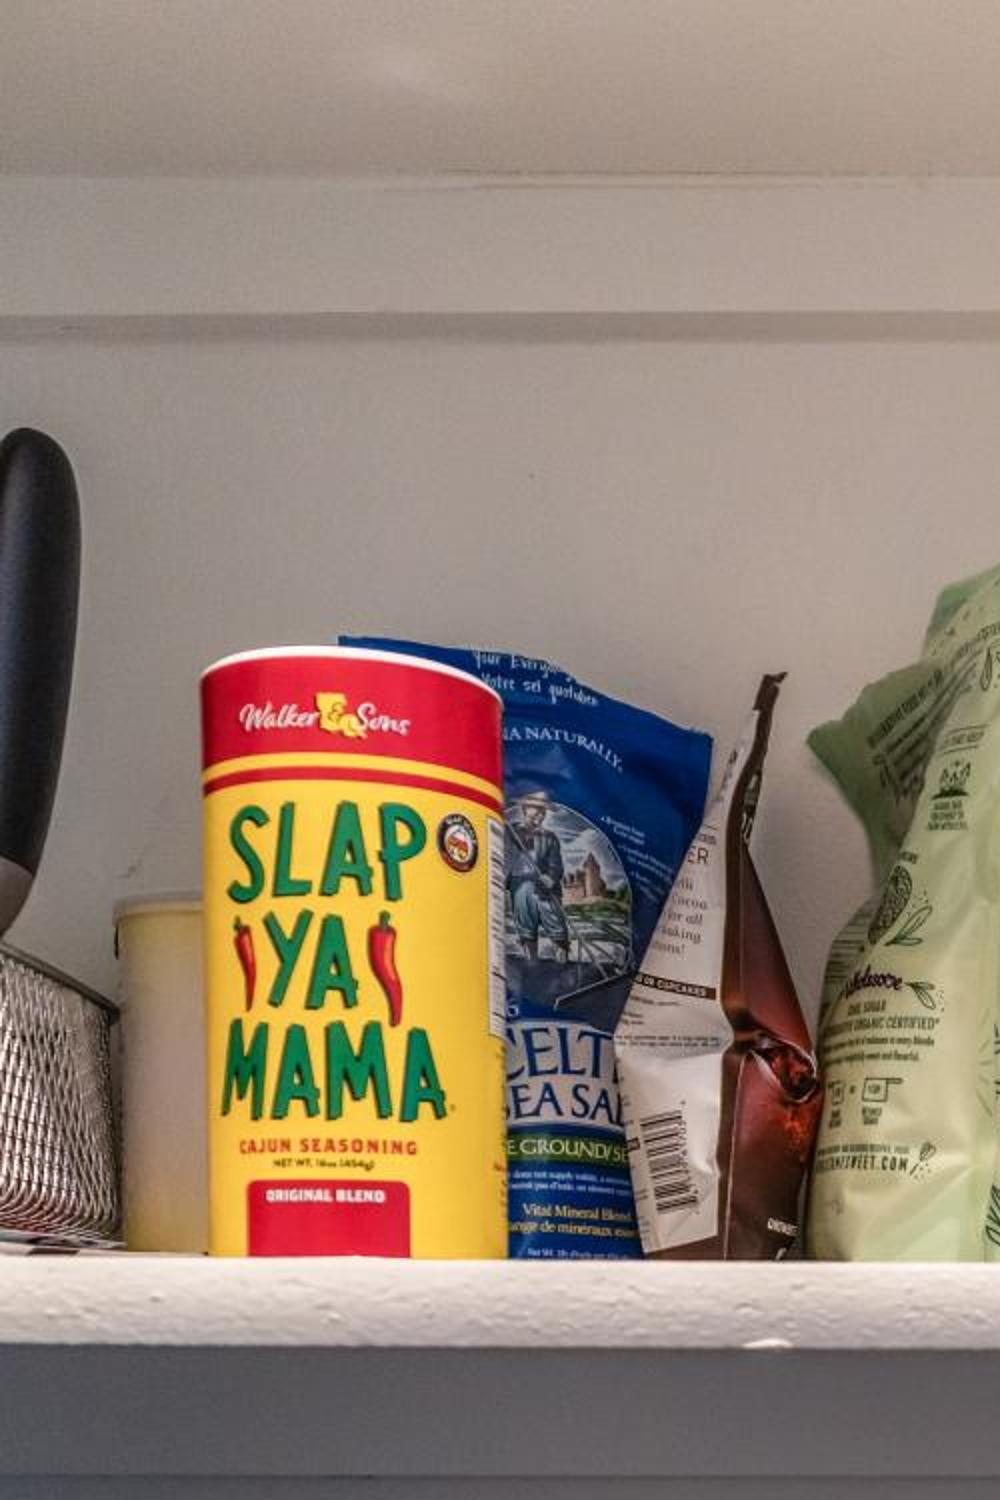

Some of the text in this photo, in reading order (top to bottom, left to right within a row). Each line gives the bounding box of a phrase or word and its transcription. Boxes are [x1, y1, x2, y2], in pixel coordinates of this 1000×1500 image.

[239, 701, 320, 732] Walker
[356, 702, 411, 739] Sons
[227, 801, 428, 904] SLAP
[262, 909, 359, 1009] YA
[221, 1018, 448, 1122] MAMA
[239, 1137, 417, 1156] CAJUN SEASONING
[265, 1188, 387, 1204] ORIGINAL BLEND
